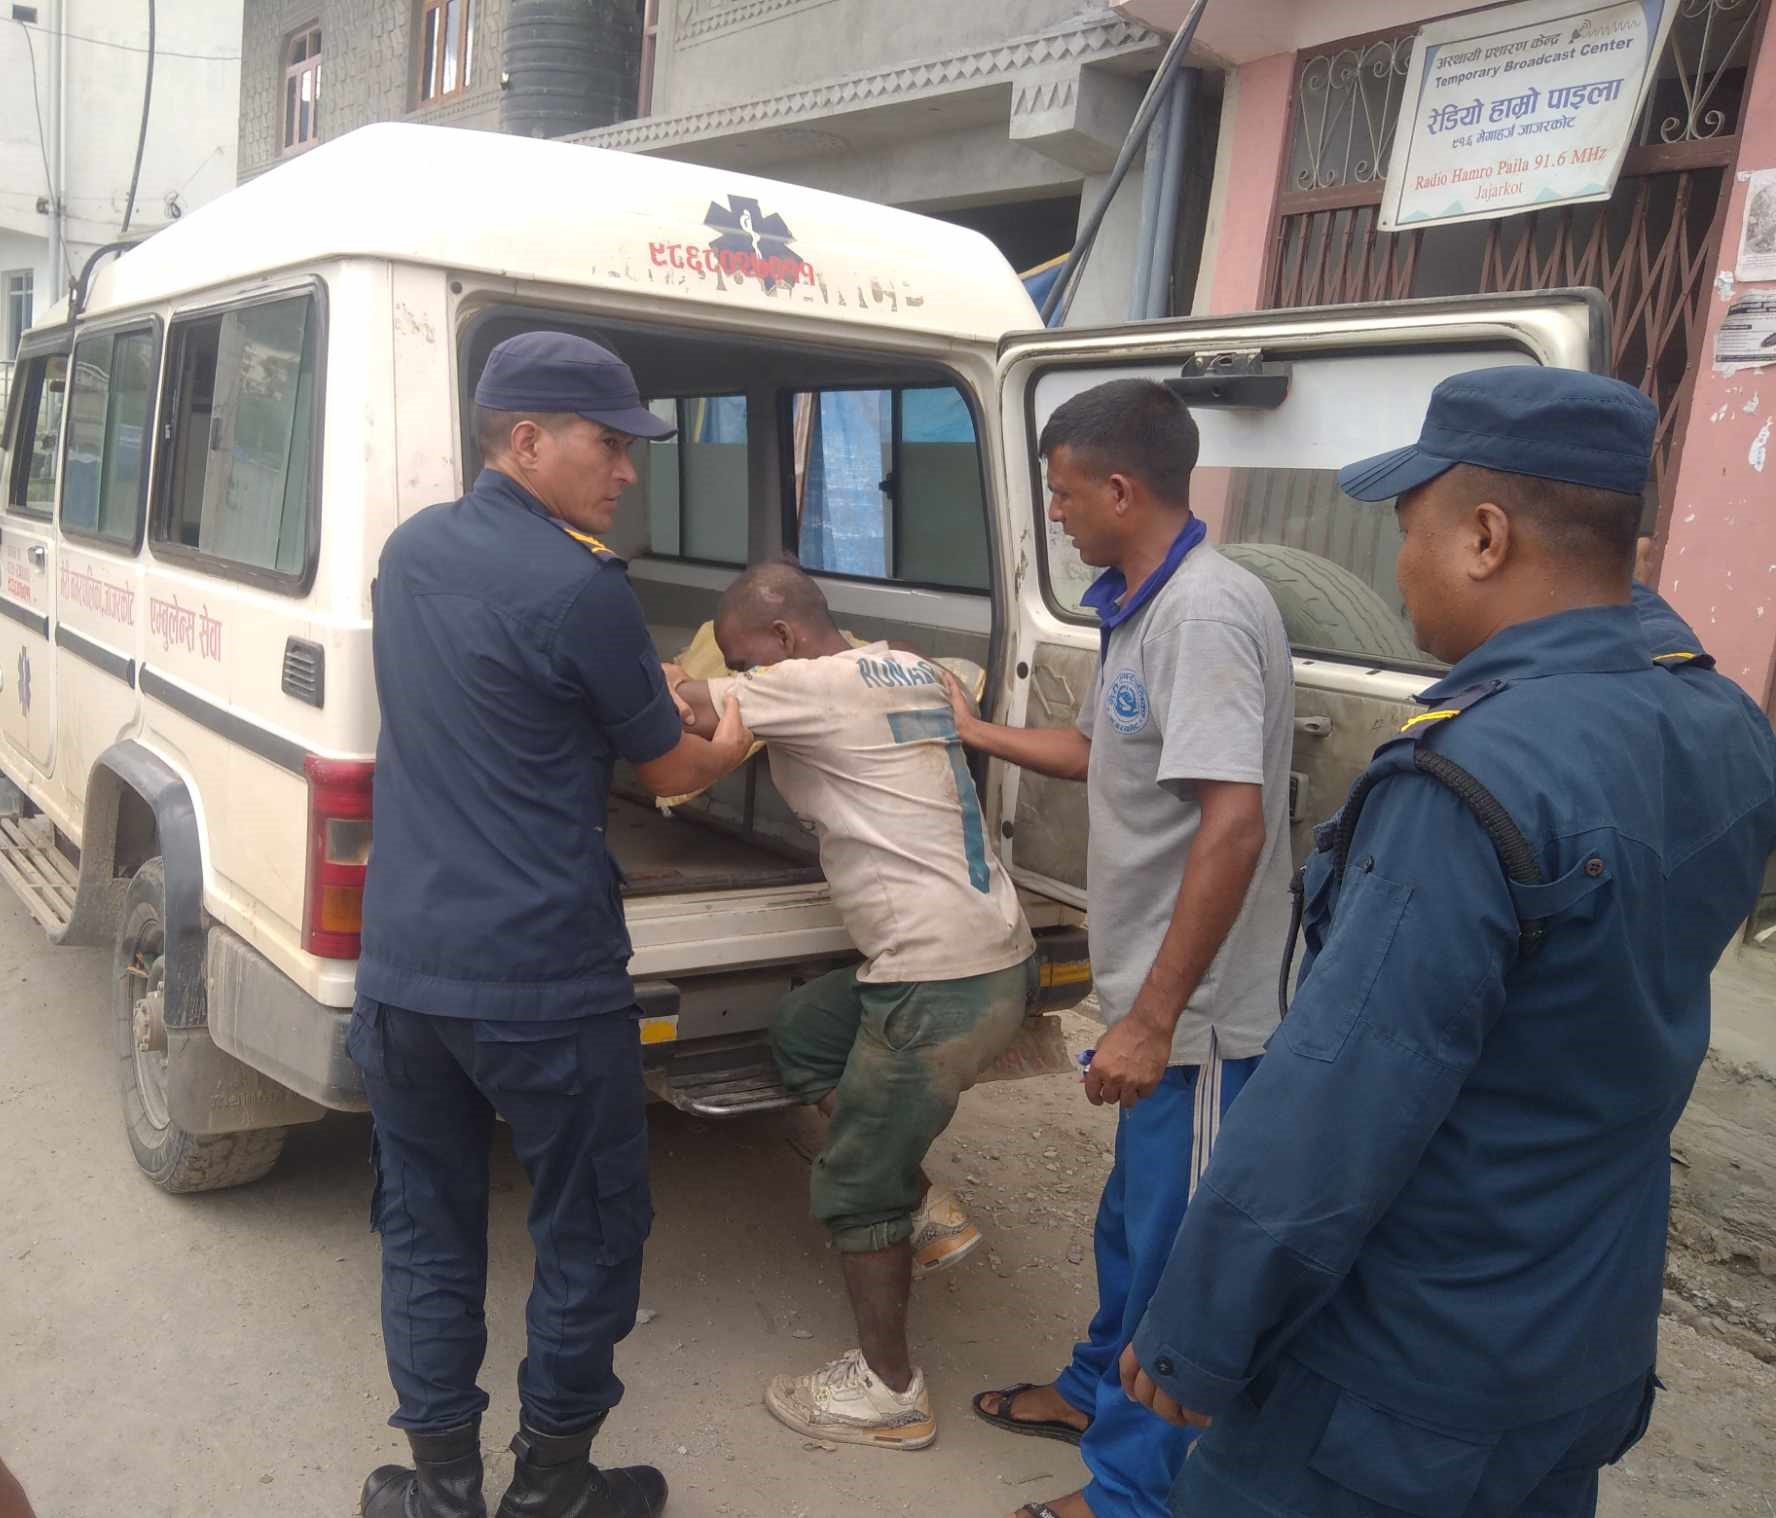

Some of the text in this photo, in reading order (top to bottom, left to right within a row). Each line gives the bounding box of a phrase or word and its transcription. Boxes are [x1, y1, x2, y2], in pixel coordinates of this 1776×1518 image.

[1435, 37, 1634, 89] Temporary Broadcast Center
[1427, 78, 1624, 135] रेडियो हाम्रो पाइला
[1415, 146, 1608, 191] Radio Hamro Paila 91.6 MHz
[1475, 182, 1524, 201] Jajarkot
